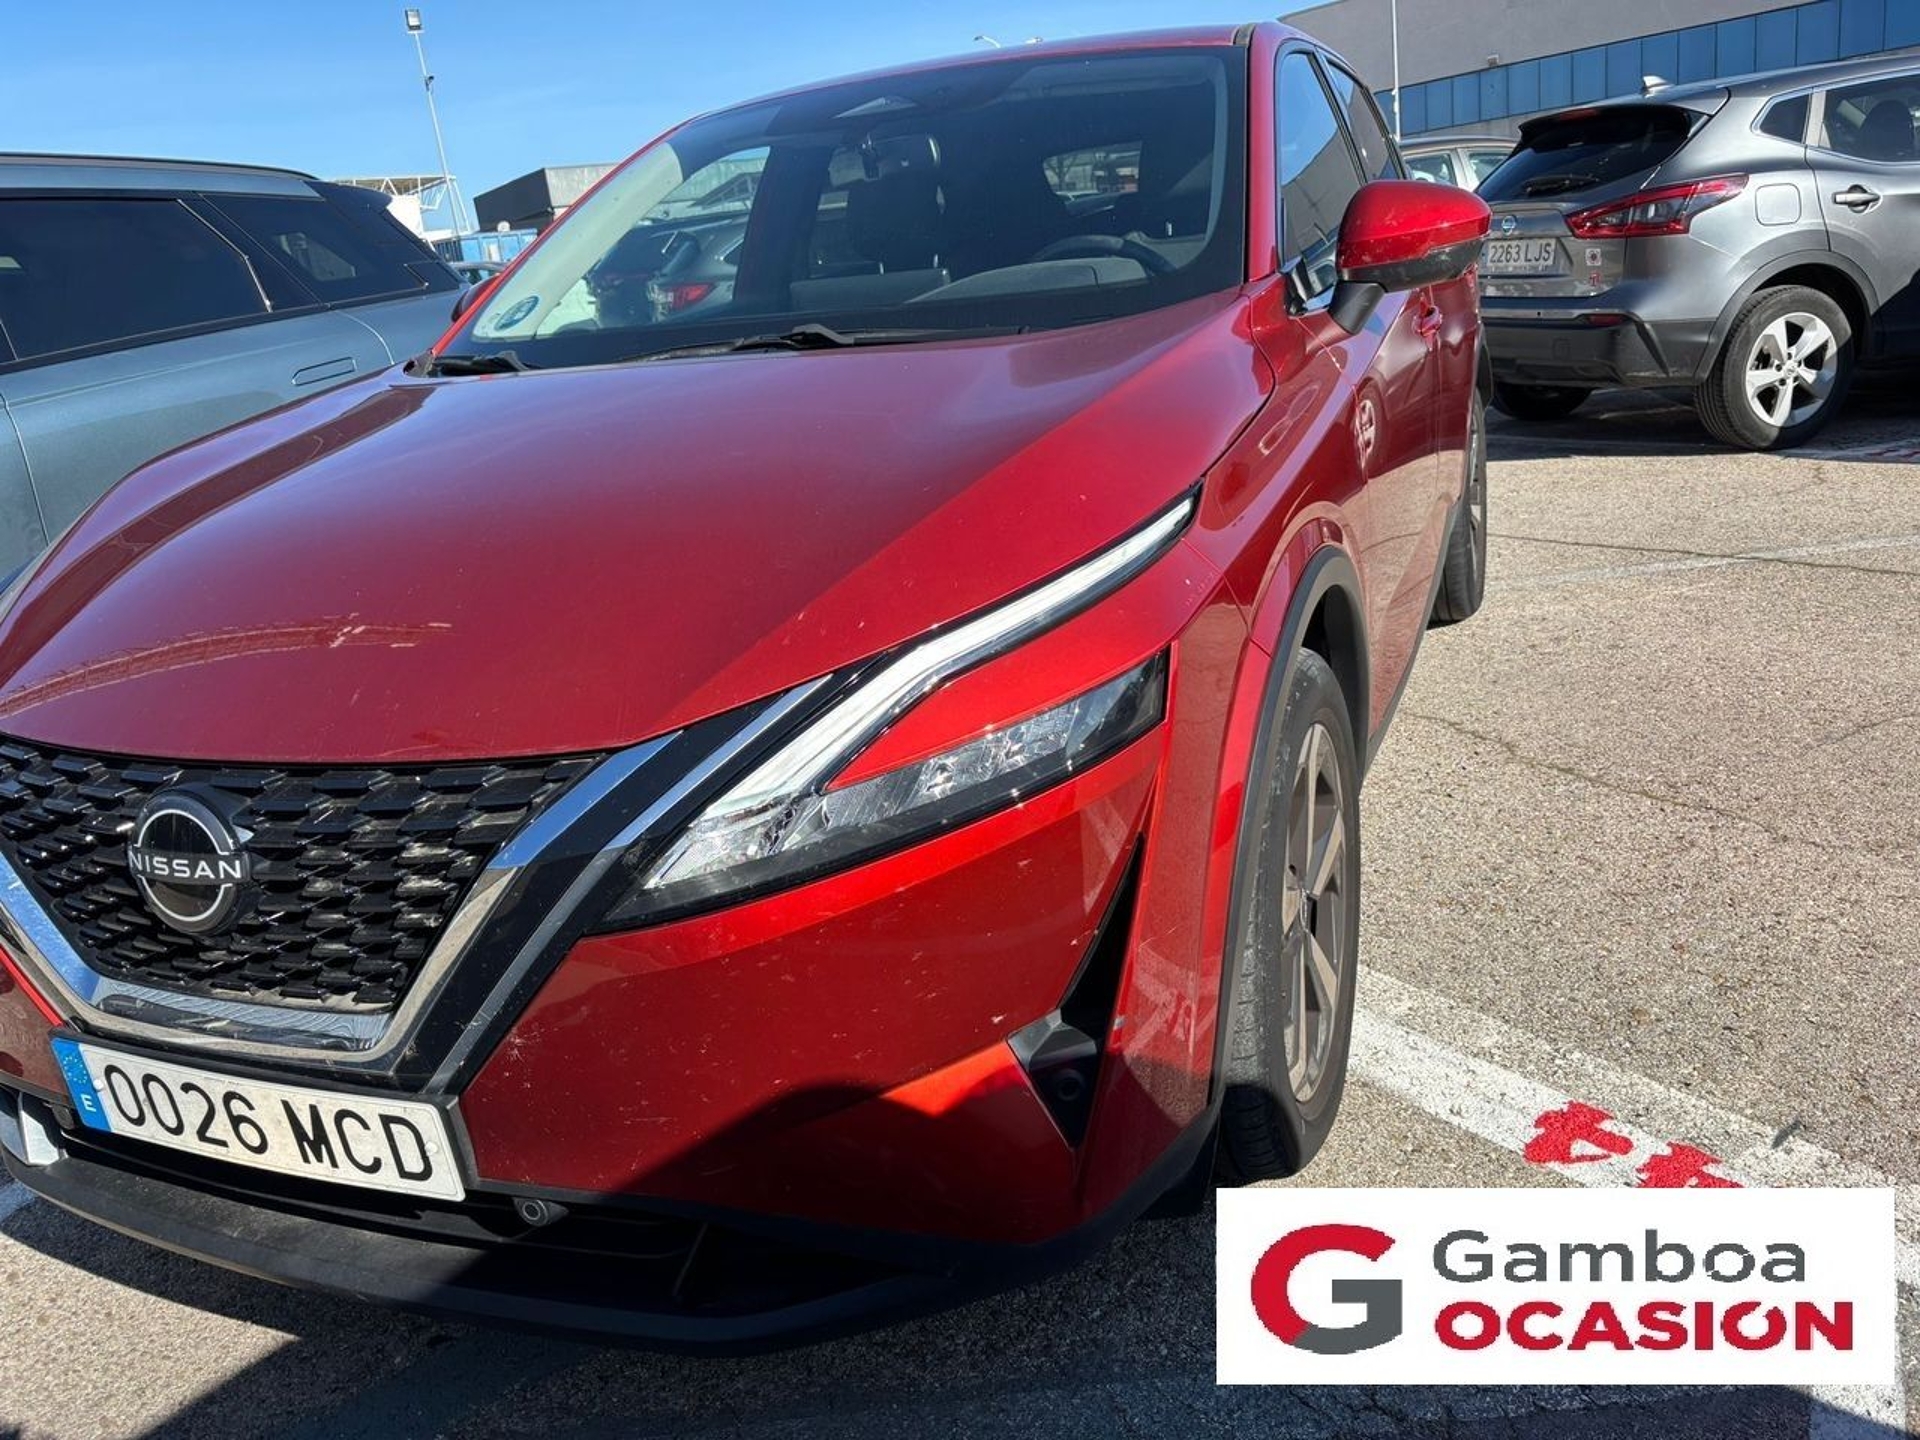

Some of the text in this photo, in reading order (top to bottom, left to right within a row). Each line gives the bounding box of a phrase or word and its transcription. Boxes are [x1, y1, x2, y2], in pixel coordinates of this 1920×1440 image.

[1489, 242, 1552, 263] 2263 LJS
[128, 849, 242, 880] NISSAN
[80, 1064, 433, 1182] E 0026 MCD
